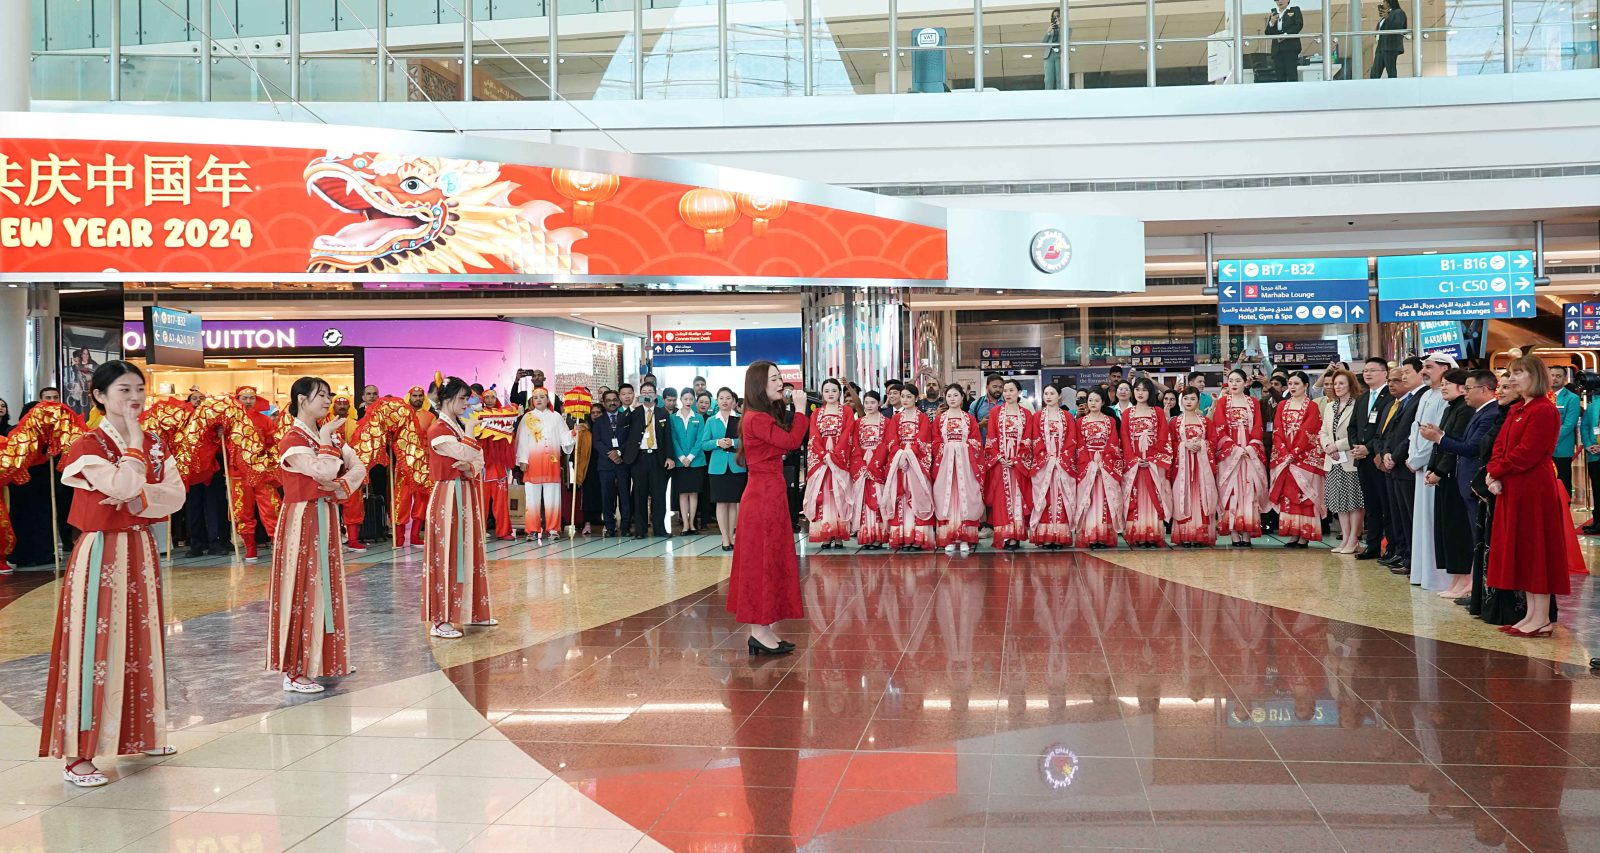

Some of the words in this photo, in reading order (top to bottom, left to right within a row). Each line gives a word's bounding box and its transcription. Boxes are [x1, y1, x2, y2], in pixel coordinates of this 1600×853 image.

[62, 217, 154, 248] YEAR
[163, 217, 254, 248] 2024
[1258, 313, 1273, 321] Gym
[1463, 307, 1491, 315] Lounges
[202, 328, 296, 349] UITTON
